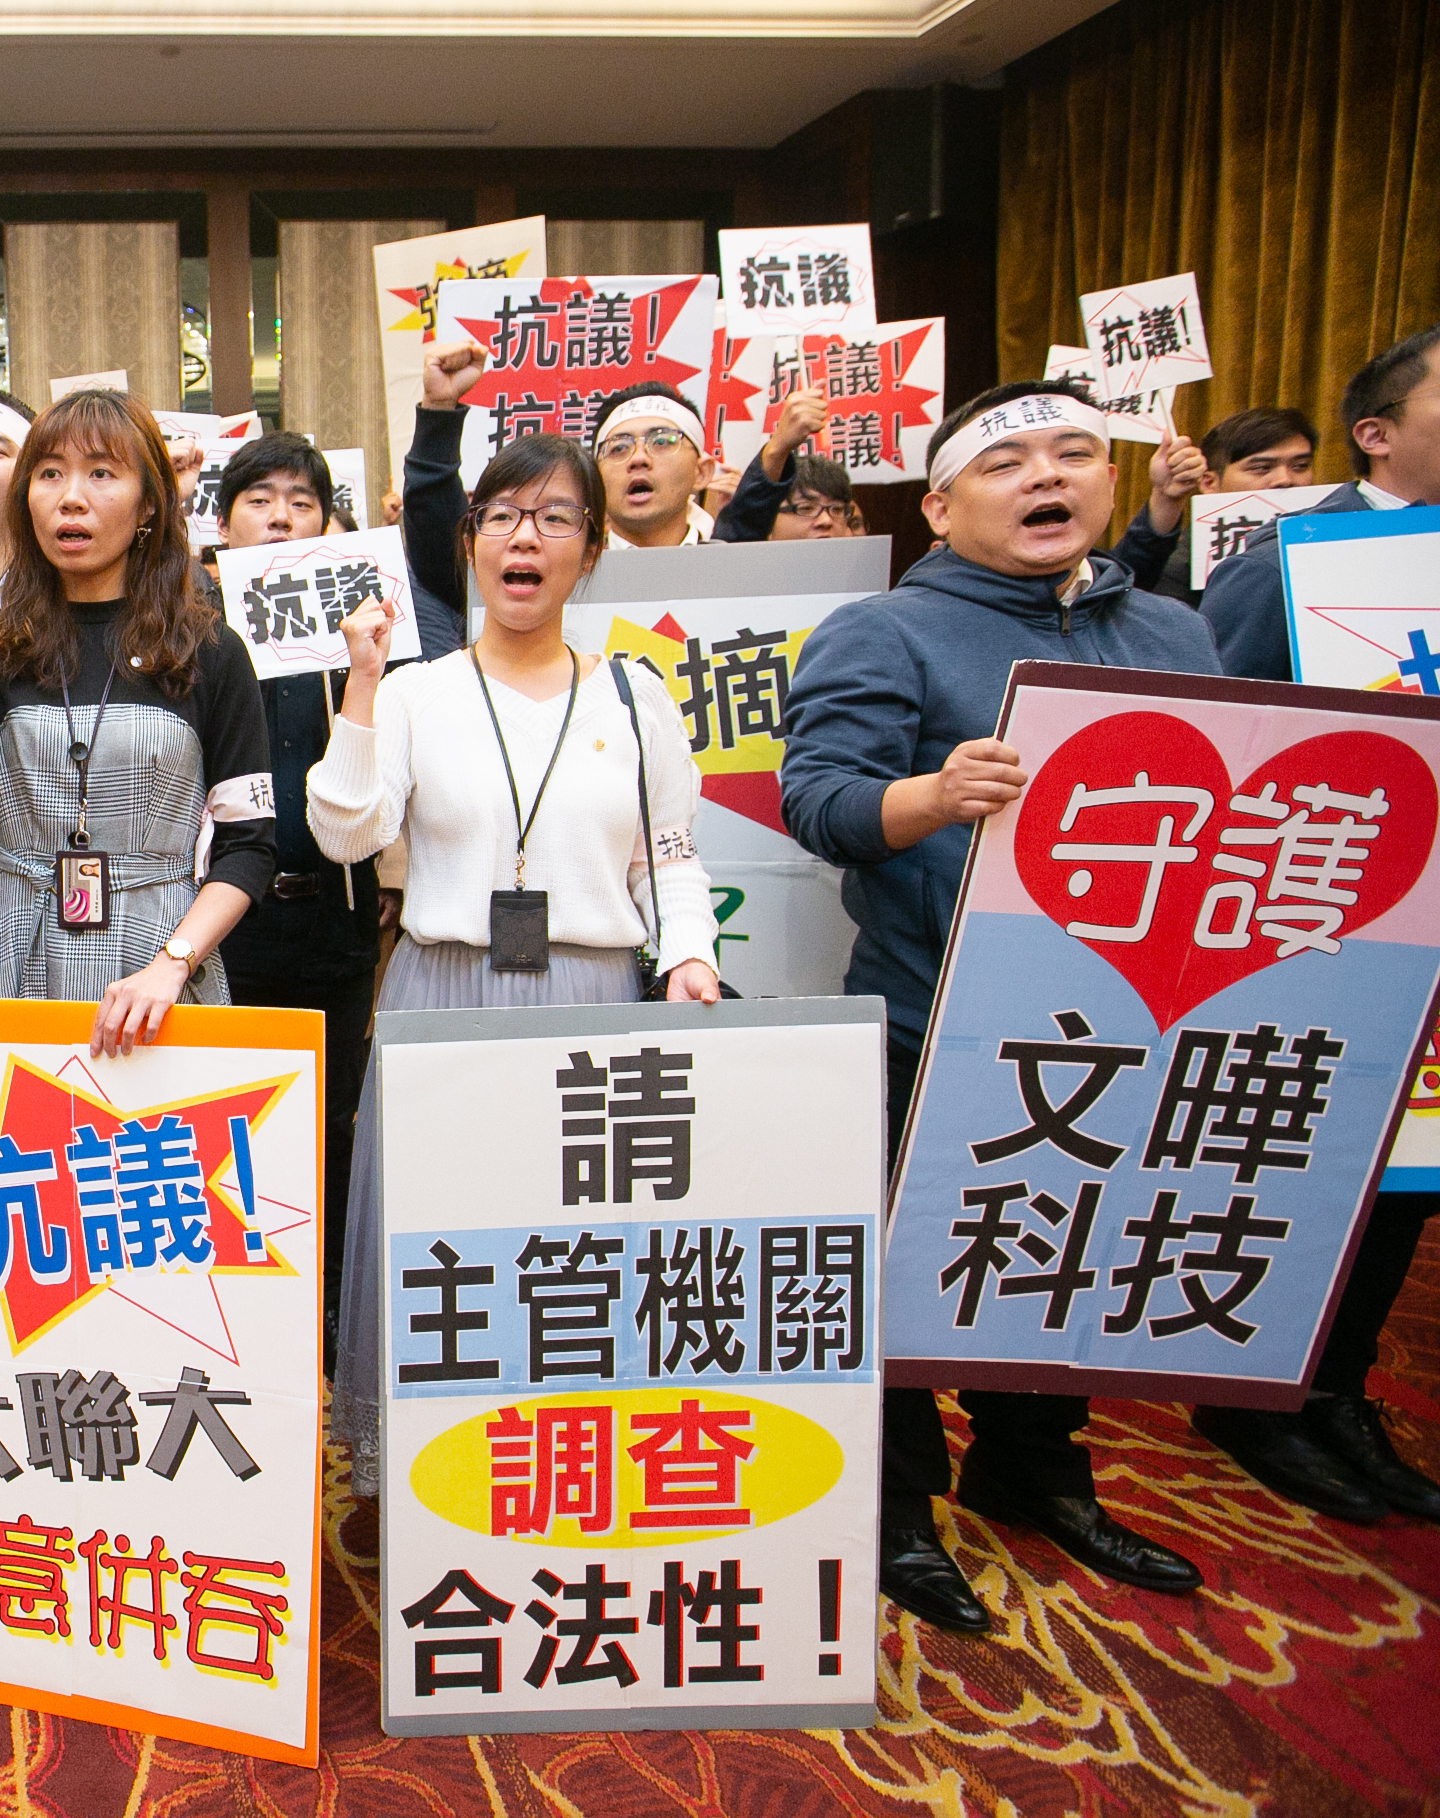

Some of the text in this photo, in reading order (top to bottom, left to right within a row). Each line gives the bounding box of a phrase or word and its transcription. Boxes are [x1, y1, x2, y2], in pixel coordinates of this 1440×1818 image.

[492, 292, 659, 368] 抗議！
[740, 253, 852, 309] 抗議
[1100, 305, 1193, 367] 抗議！
[979, 396, 1070, 438] 抗議
[243, 562, 385, 644] 抗議
[1050, 770, 1390, 960] 守護
[557, 1047, 695, 1206] 請
[968, 1008, 1348, 1187] 文曄
[397, 1223, 866, 1385] 主管機關
[942, 1178, 1293, 1348] 科技
[485, 1399, 756, 1538] 調查
[400, 1558, 843, 1697] 合法性！
